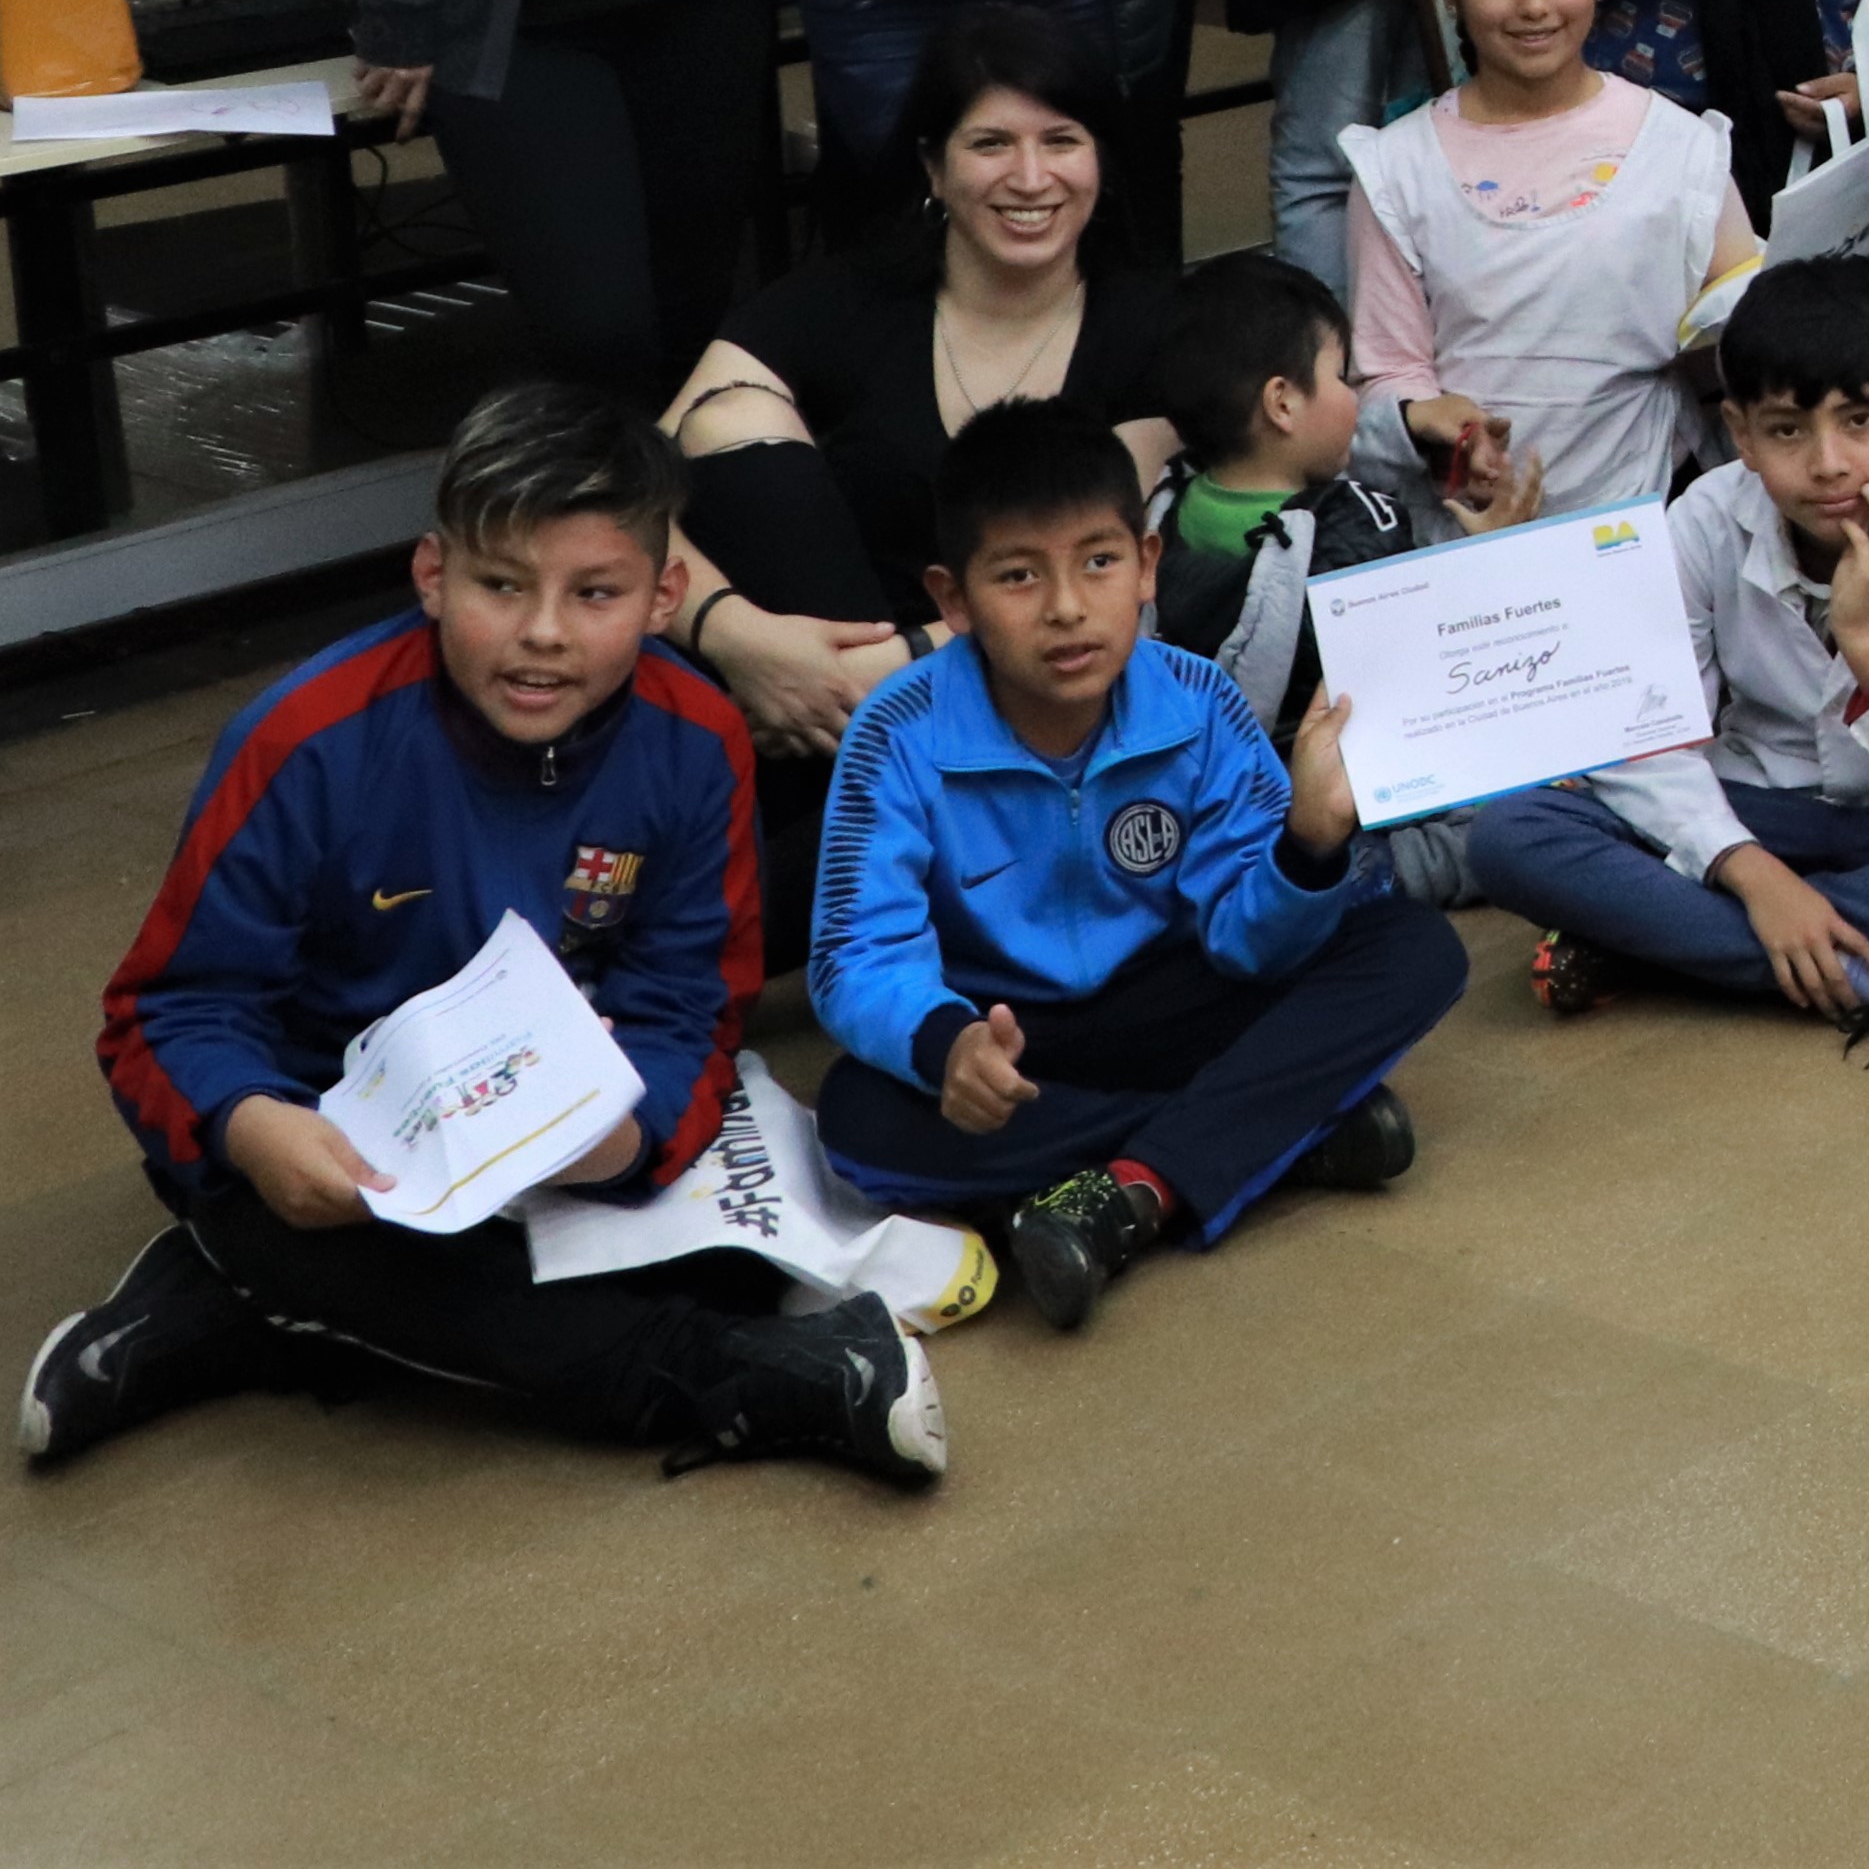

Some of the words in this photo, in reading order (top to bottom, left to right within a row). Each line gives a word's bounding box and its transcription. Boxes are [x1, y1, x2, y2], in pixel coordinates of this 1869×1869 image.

[1437, 612, 1501, 637] Familias
[1504, 597, 1562, 621] Fuertes
[1446, 641, 1561, 695] Sanizo
[1392, 774, 1436, 794] UNODC
